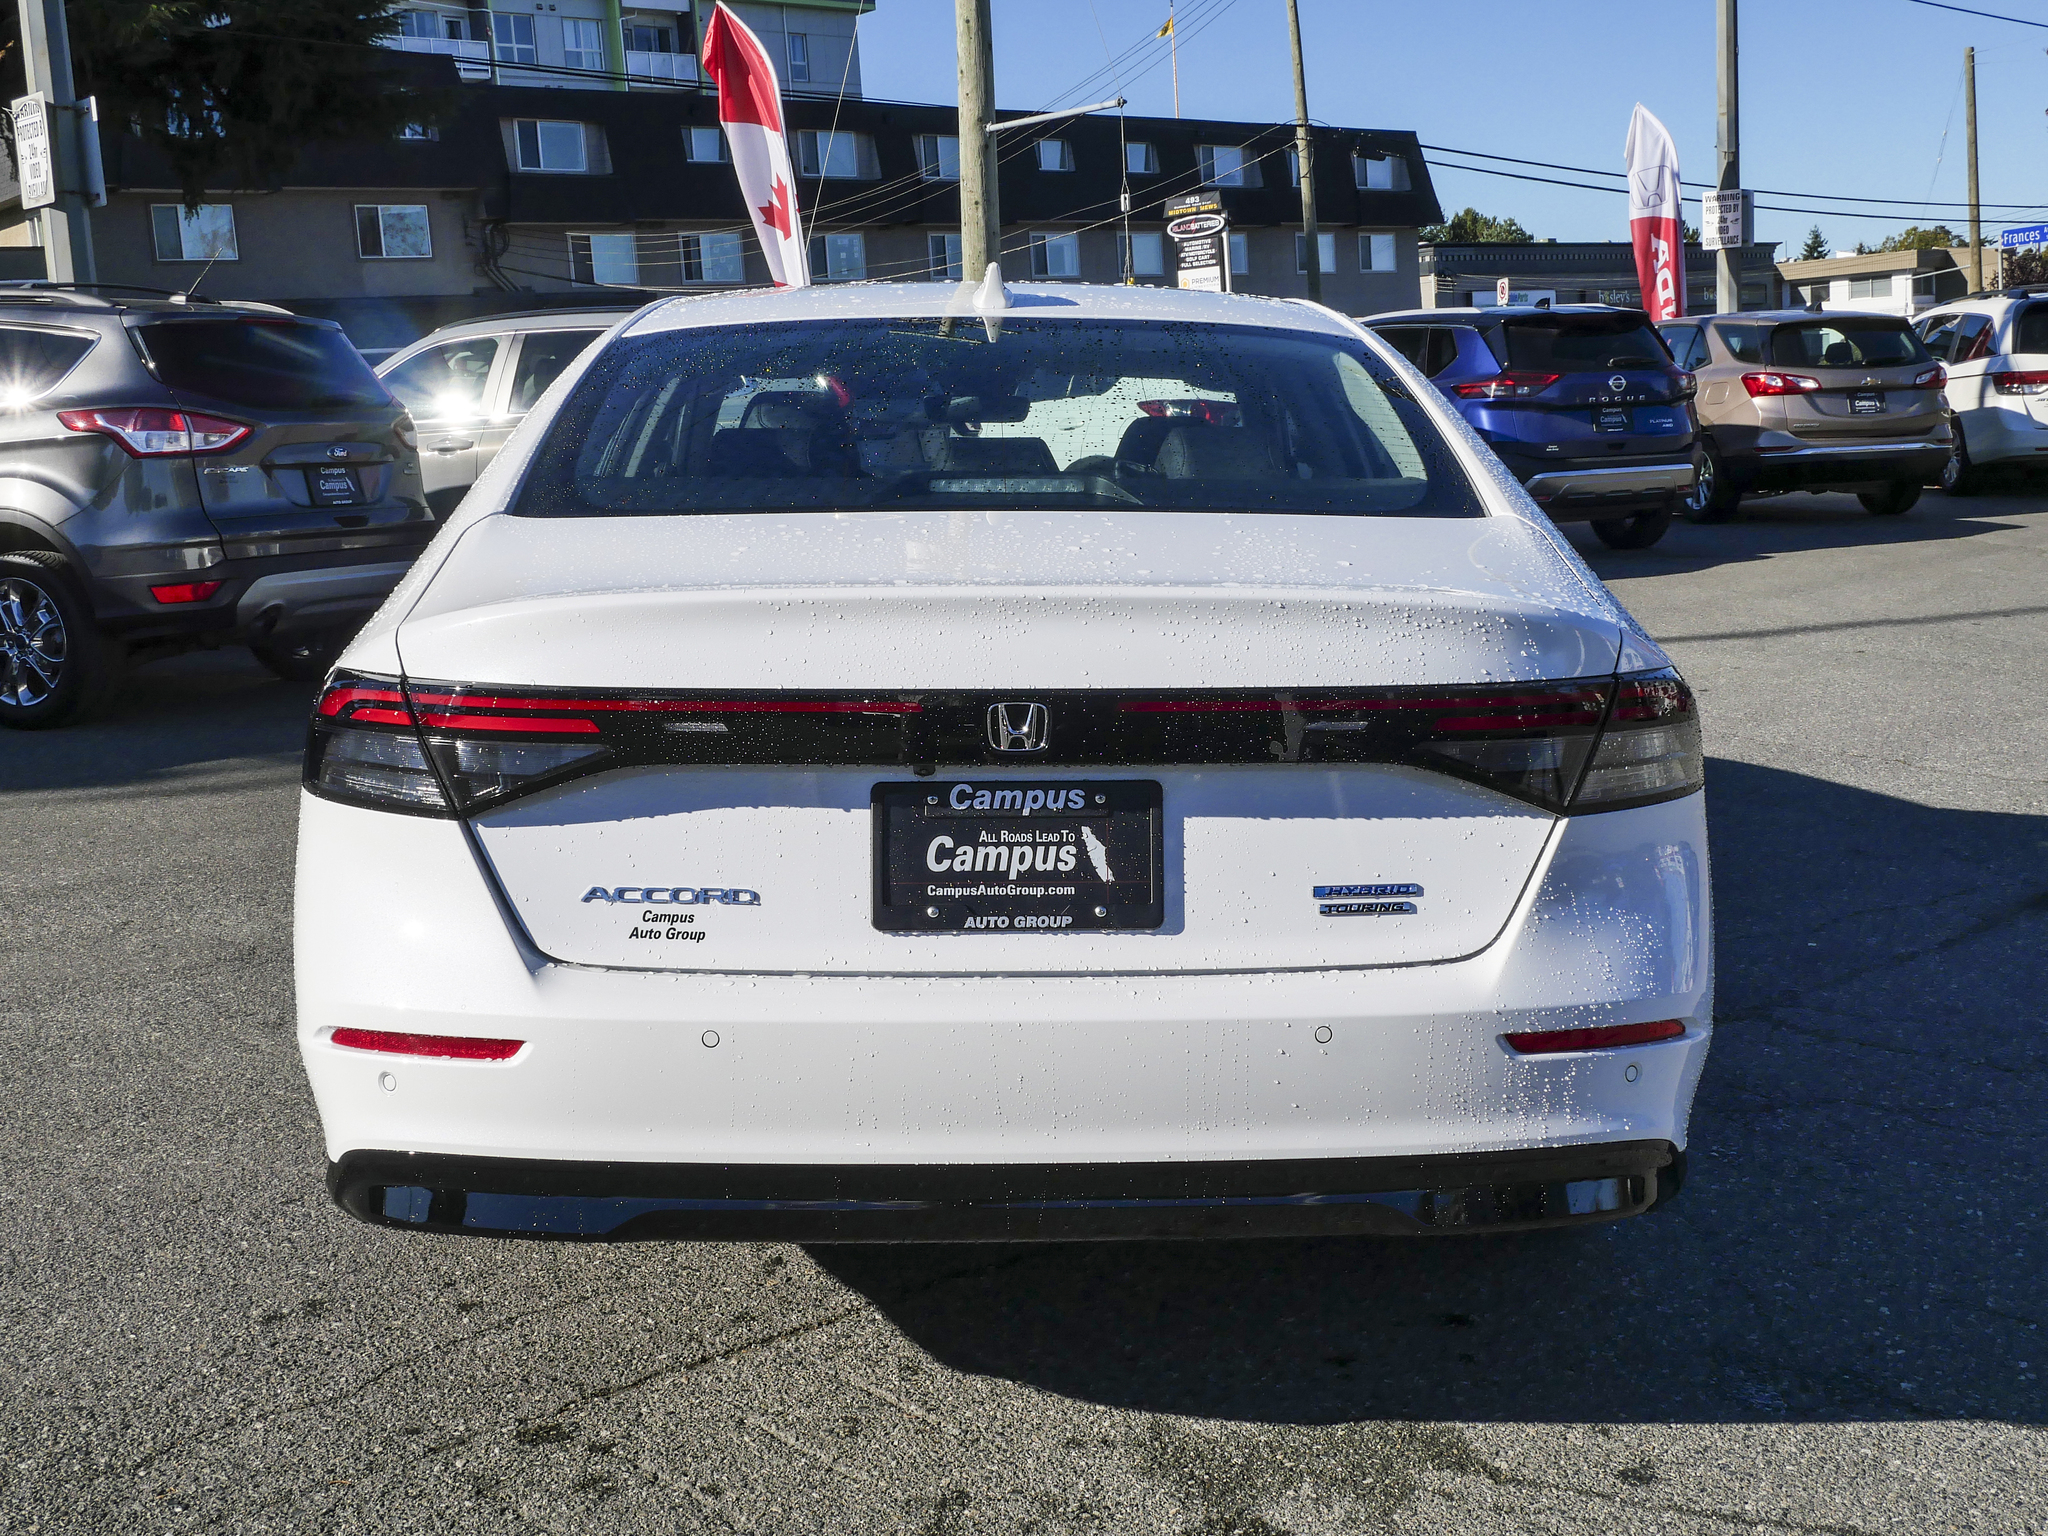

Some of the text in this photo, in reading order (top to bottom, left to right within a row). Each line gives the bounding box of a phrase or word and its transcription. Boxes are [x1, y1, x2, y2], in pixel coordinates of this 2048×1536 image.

[29, 162, 41, 180] VIDEO
[1185, 196, 1200, 204] 493
[1705, 192, 1740, 203] WARNING
[1168, 203, 1218, 216] MIDTOWN MEWS
[1705, 203, 1740, 215] PROTECTED BY
[1715, 225, 1730, 235] VIDEO
[1705, 235, 1740, 247] SURVEILLANCE
[2003, 230, 2040, 245] Frances
[1191, 276, 1220, 285] PREMIUM
[1588, 394, 1646, 403] ROGUE
[333, 447, 348, 457] Ford
[320, 466, 346, 476] Campus
[319, 480, 348, 492] Campus
[949, 783, 1086, 816] Campus
[926, 835, 1077, 881] Campus
[580, 886, 762, 906] ACCORD
[927, 884, 1076, 898] CampusAutoGroup.com
[1325, 884, 1413, 897] HYBRID
[1324, 902, 1405, 914] TOURING
[642, 909, 695, 926] Campus
[964, 915, 1074, 929] AUTO GROUP
[629, 926, 706, 943] Auto Group
